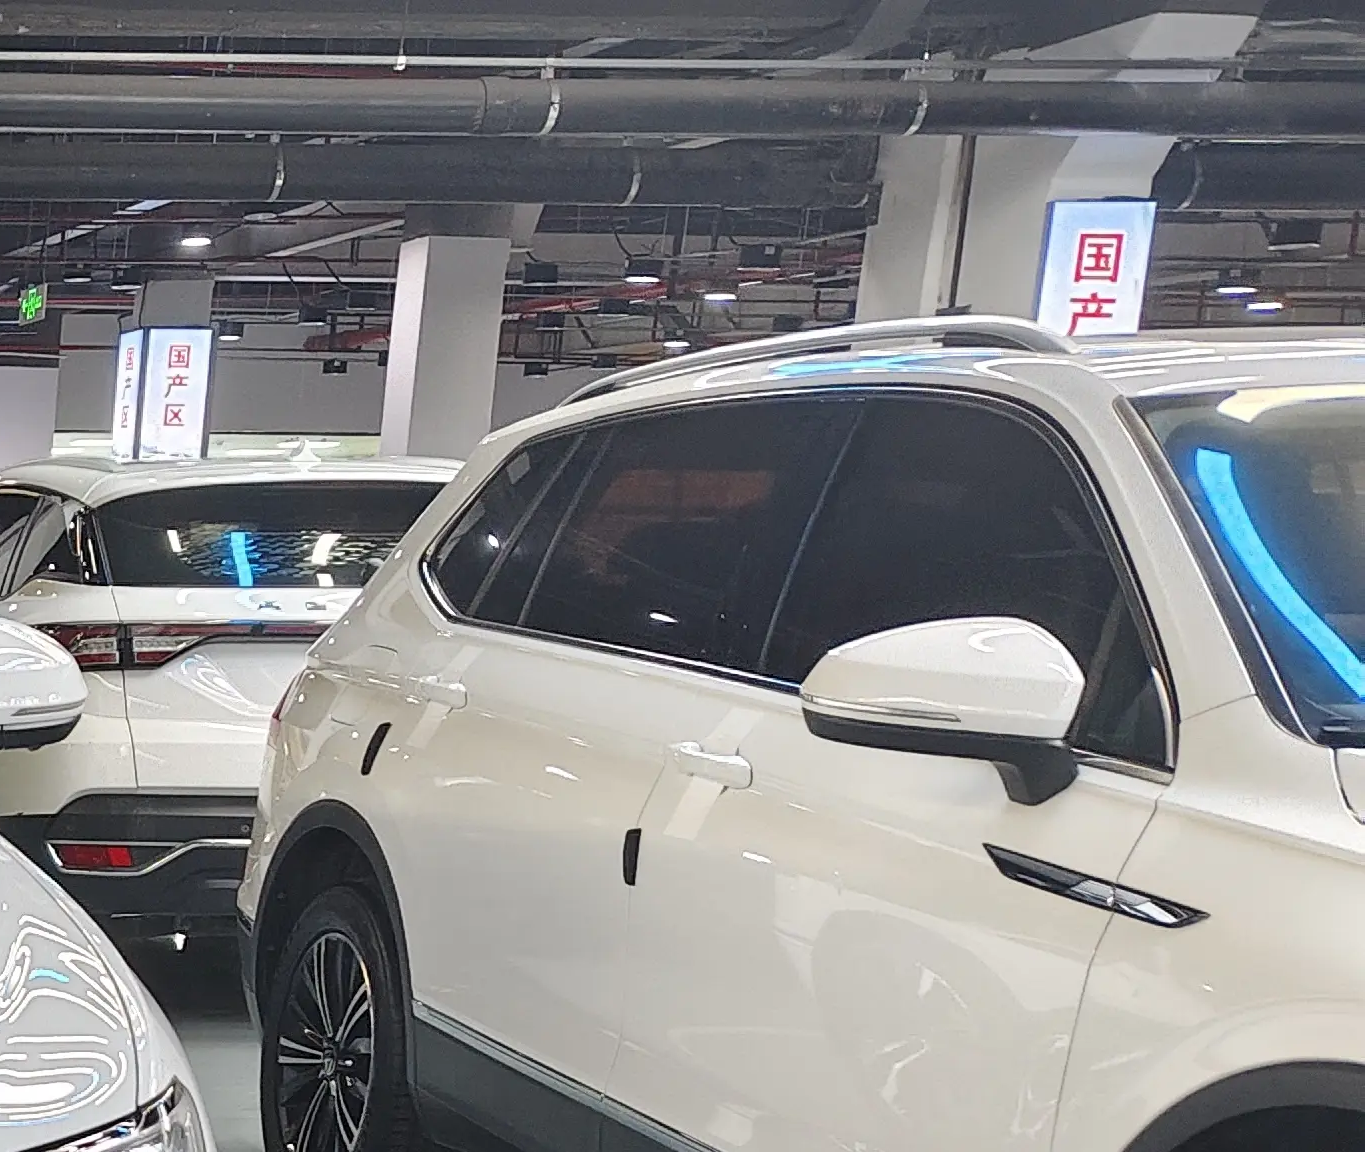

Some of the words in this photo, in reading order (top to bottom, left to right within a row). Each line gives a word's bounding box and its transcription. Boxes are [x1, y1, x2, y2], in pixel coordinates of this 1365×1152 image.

[1066, 233, 1125, 336] 国产
[163, 343, 192, 427] 国产区
